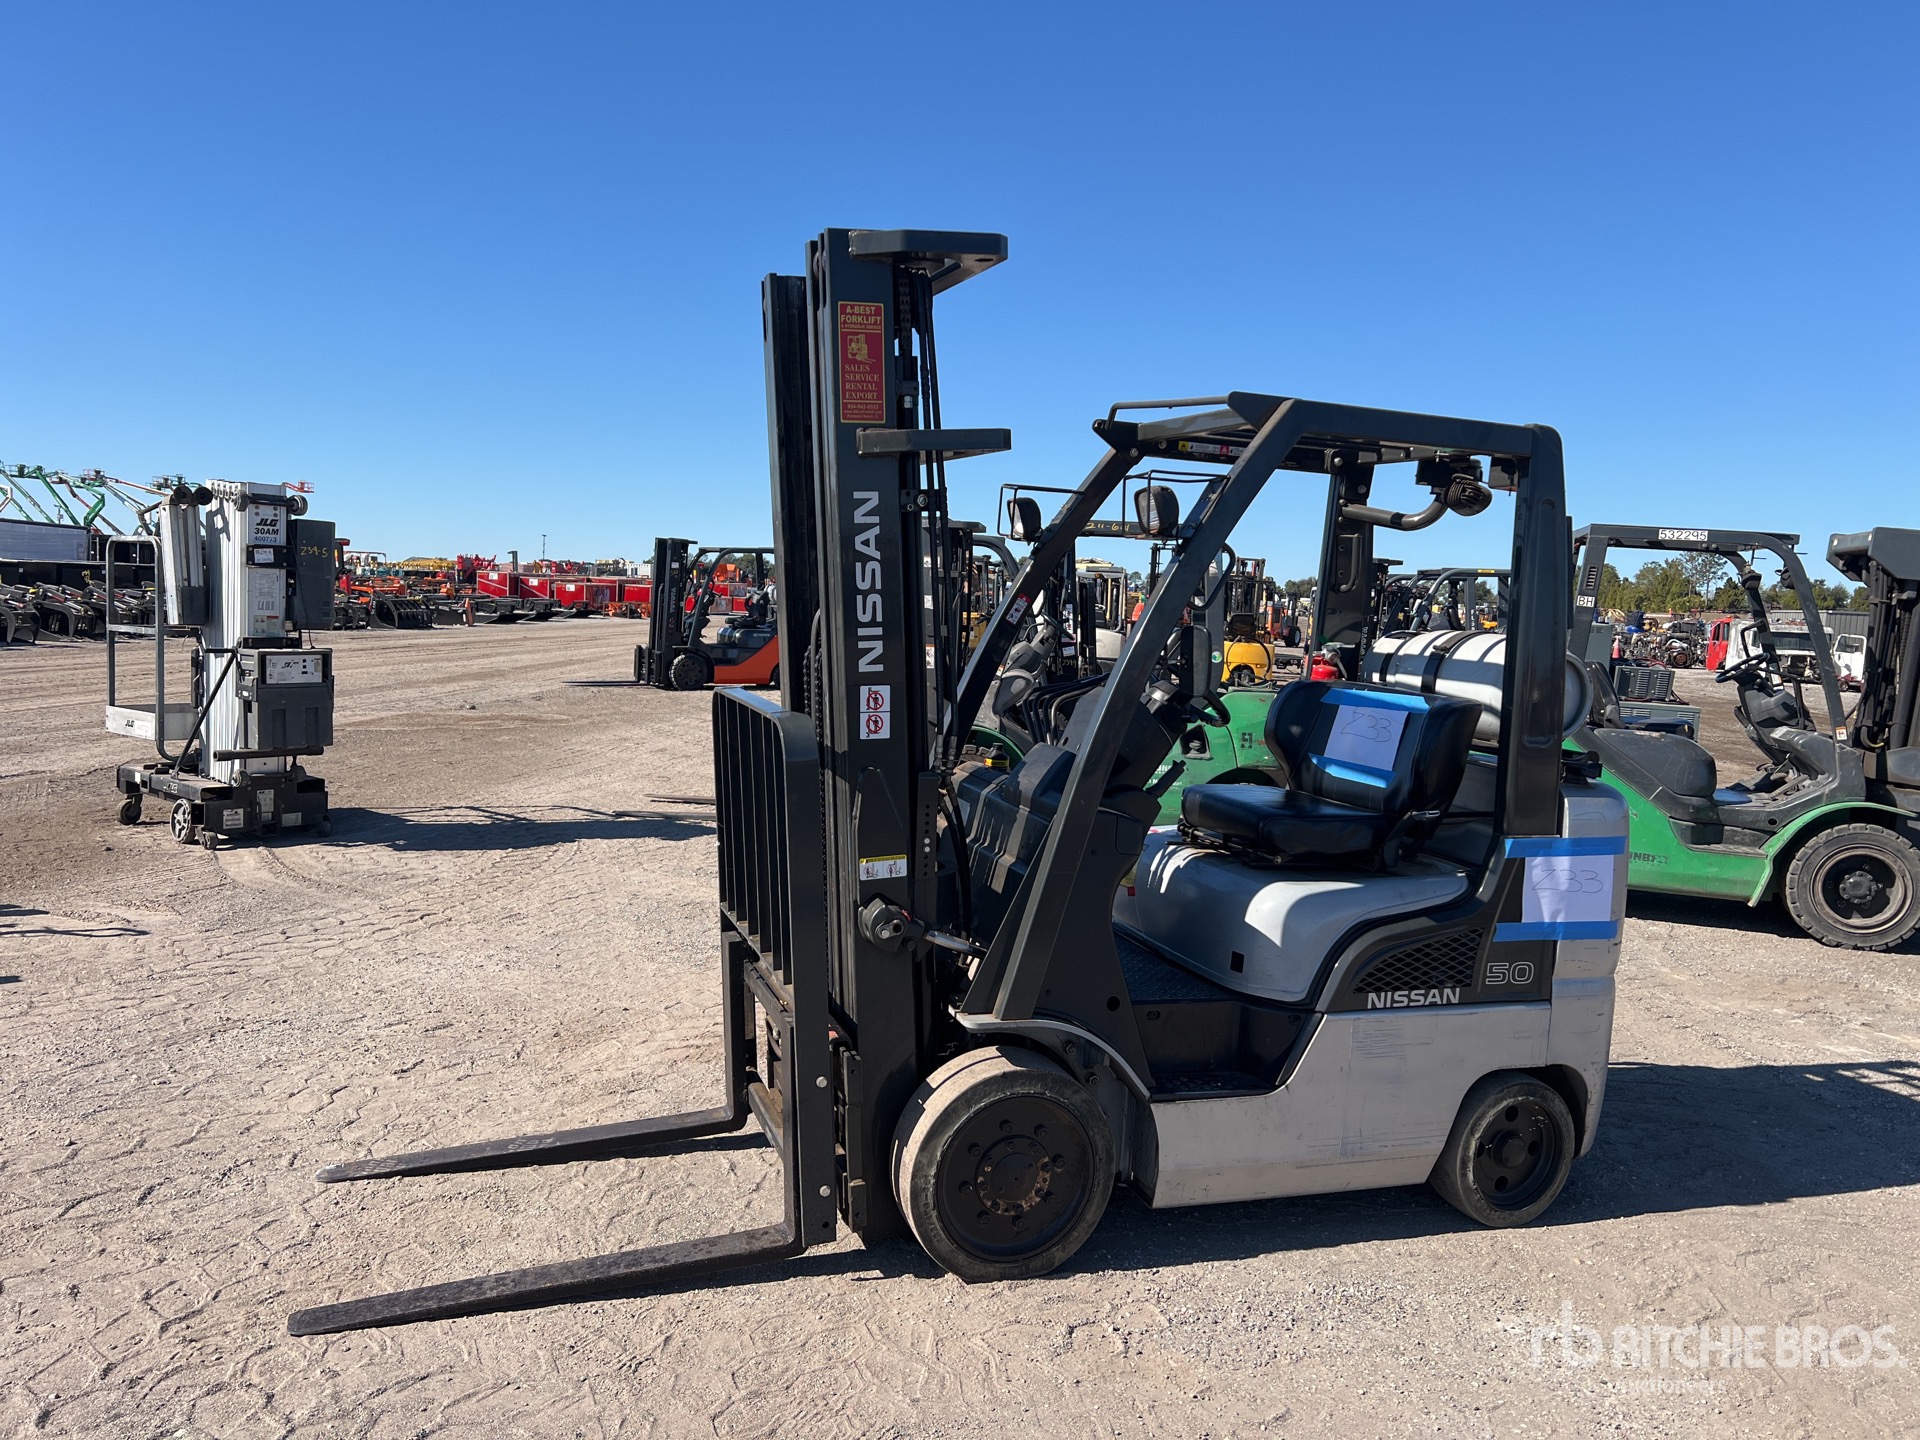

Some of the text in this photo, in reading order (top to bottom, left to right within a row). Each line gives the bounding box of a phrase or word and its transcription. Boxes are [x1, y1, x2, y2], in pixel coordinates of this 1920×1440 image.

[846, 305, 876, 315] A-BEST
[840, 315, 881, 325] FORKLIFT
[845, 364, 870, 372] SALES
[845, 373, 880, 382] SERVICE
[845, 382, 877, 391] RENTAL
[846, 391, 878, 400] EXPORT
[255, 518, 279, 527] JLG
[254, 527, 279, 535] 30AM
[1660, 529, 1707, 541] 532295
[853, 491, 884, 672] NISSAN
[1578, 596, 1595, 607] BH
[1485, 961, 1535, 985] 50
[1367, 987, 1460, 1009] NISSAN
